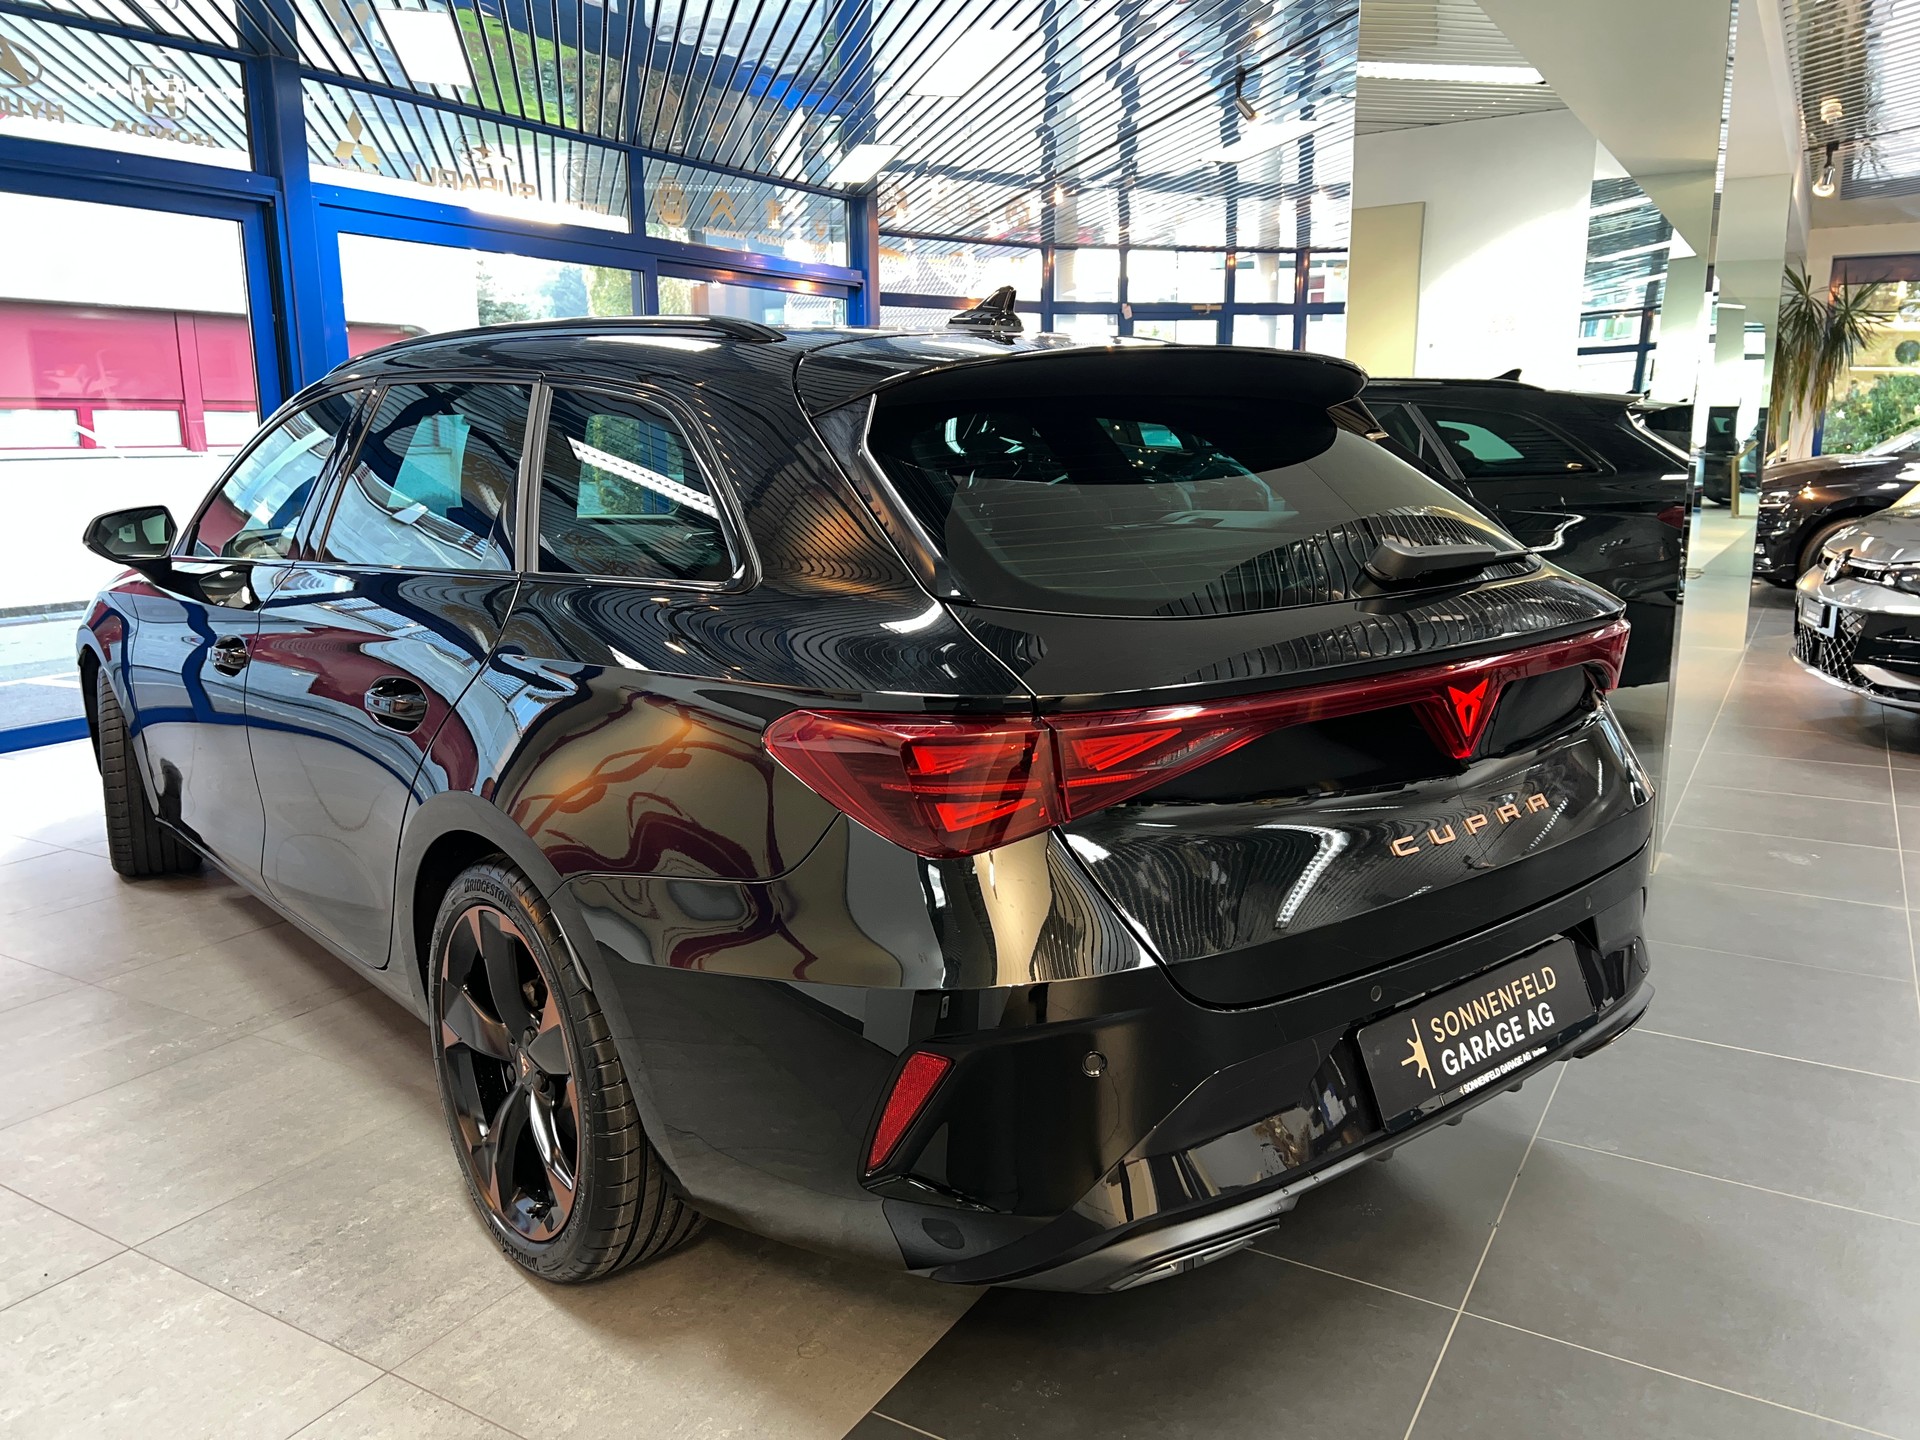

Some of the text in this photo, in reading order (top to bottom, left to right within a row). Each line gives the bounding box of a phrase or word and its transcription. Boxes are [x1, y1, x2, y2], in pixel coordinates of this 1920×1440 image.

[1389, 793, 1550, 857] CUPRA
[1430, 966, 1557, 1043] SONNENFELD
[1441, 1002, 1556, 1076] GARAGE AG
[1463, 1067, 1501, 1094] SONNENFELD
[1500, 1055, 1524, 1074] GARAGE
